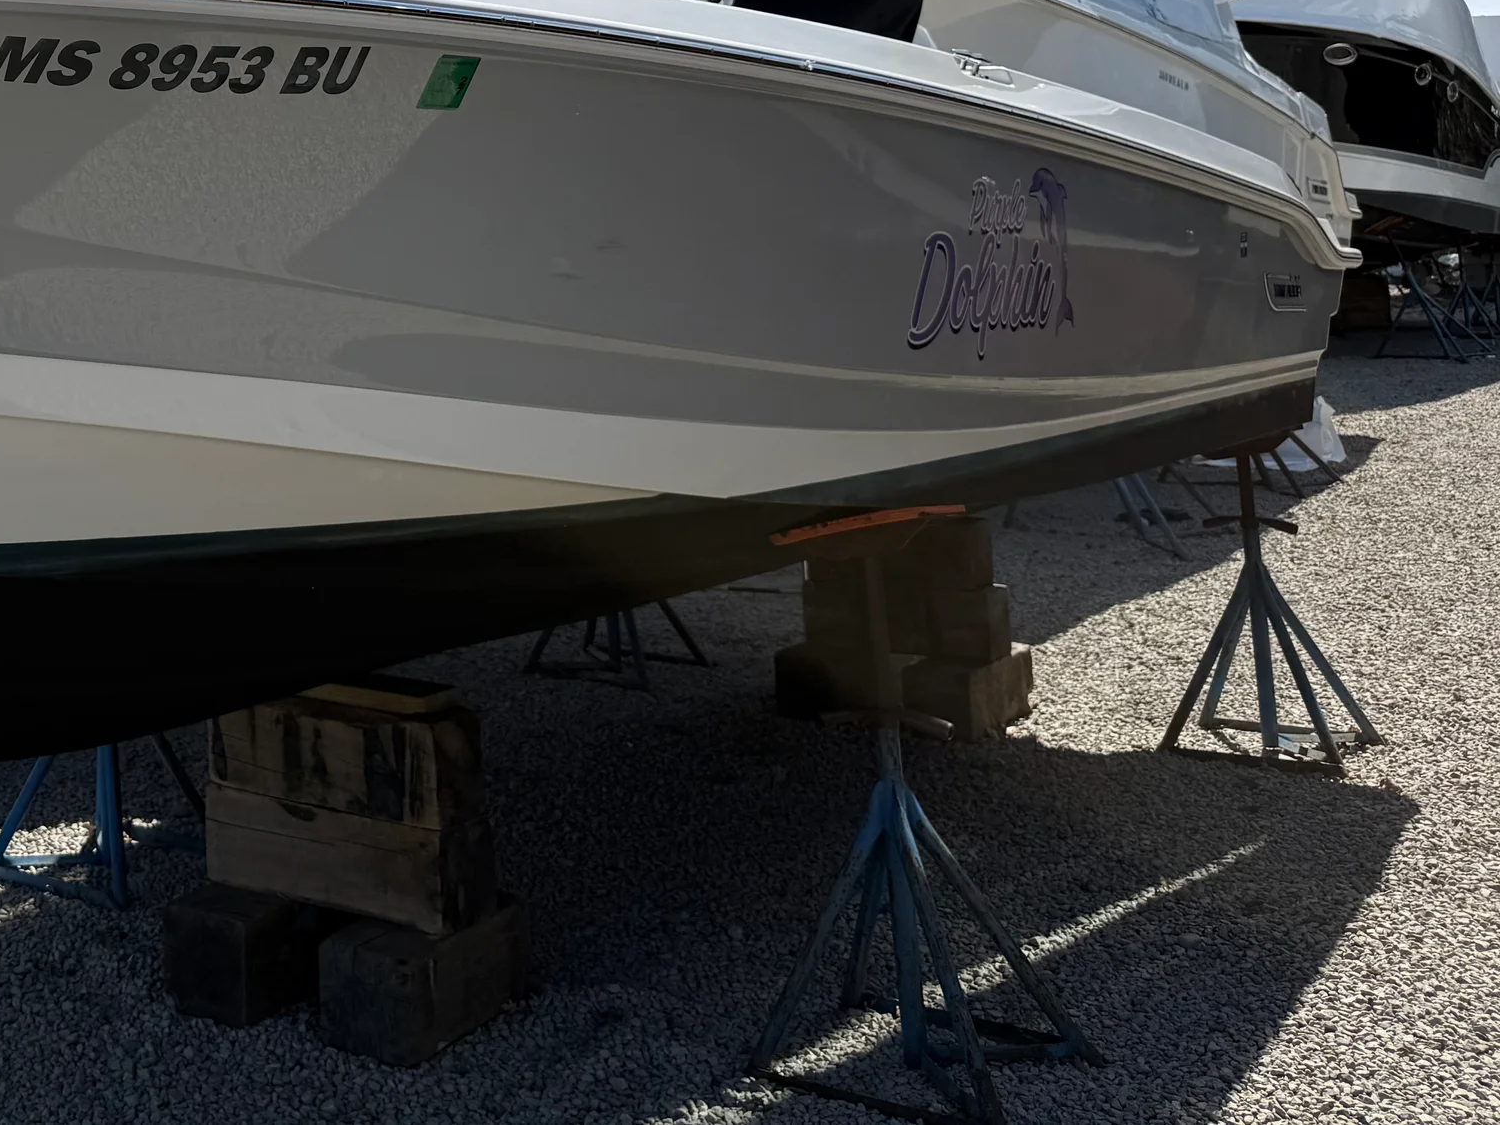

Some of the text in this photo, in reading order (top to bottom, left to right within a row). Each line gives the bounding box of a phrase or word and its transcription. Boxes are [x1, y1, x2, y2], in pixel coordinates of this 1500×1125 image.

[108, 42, 275, 95] 8953
[279, 45, 372, 95] BU
[968, 177, 1027, 248] Purple
[906, 230, 1056, 361] Dolphin
